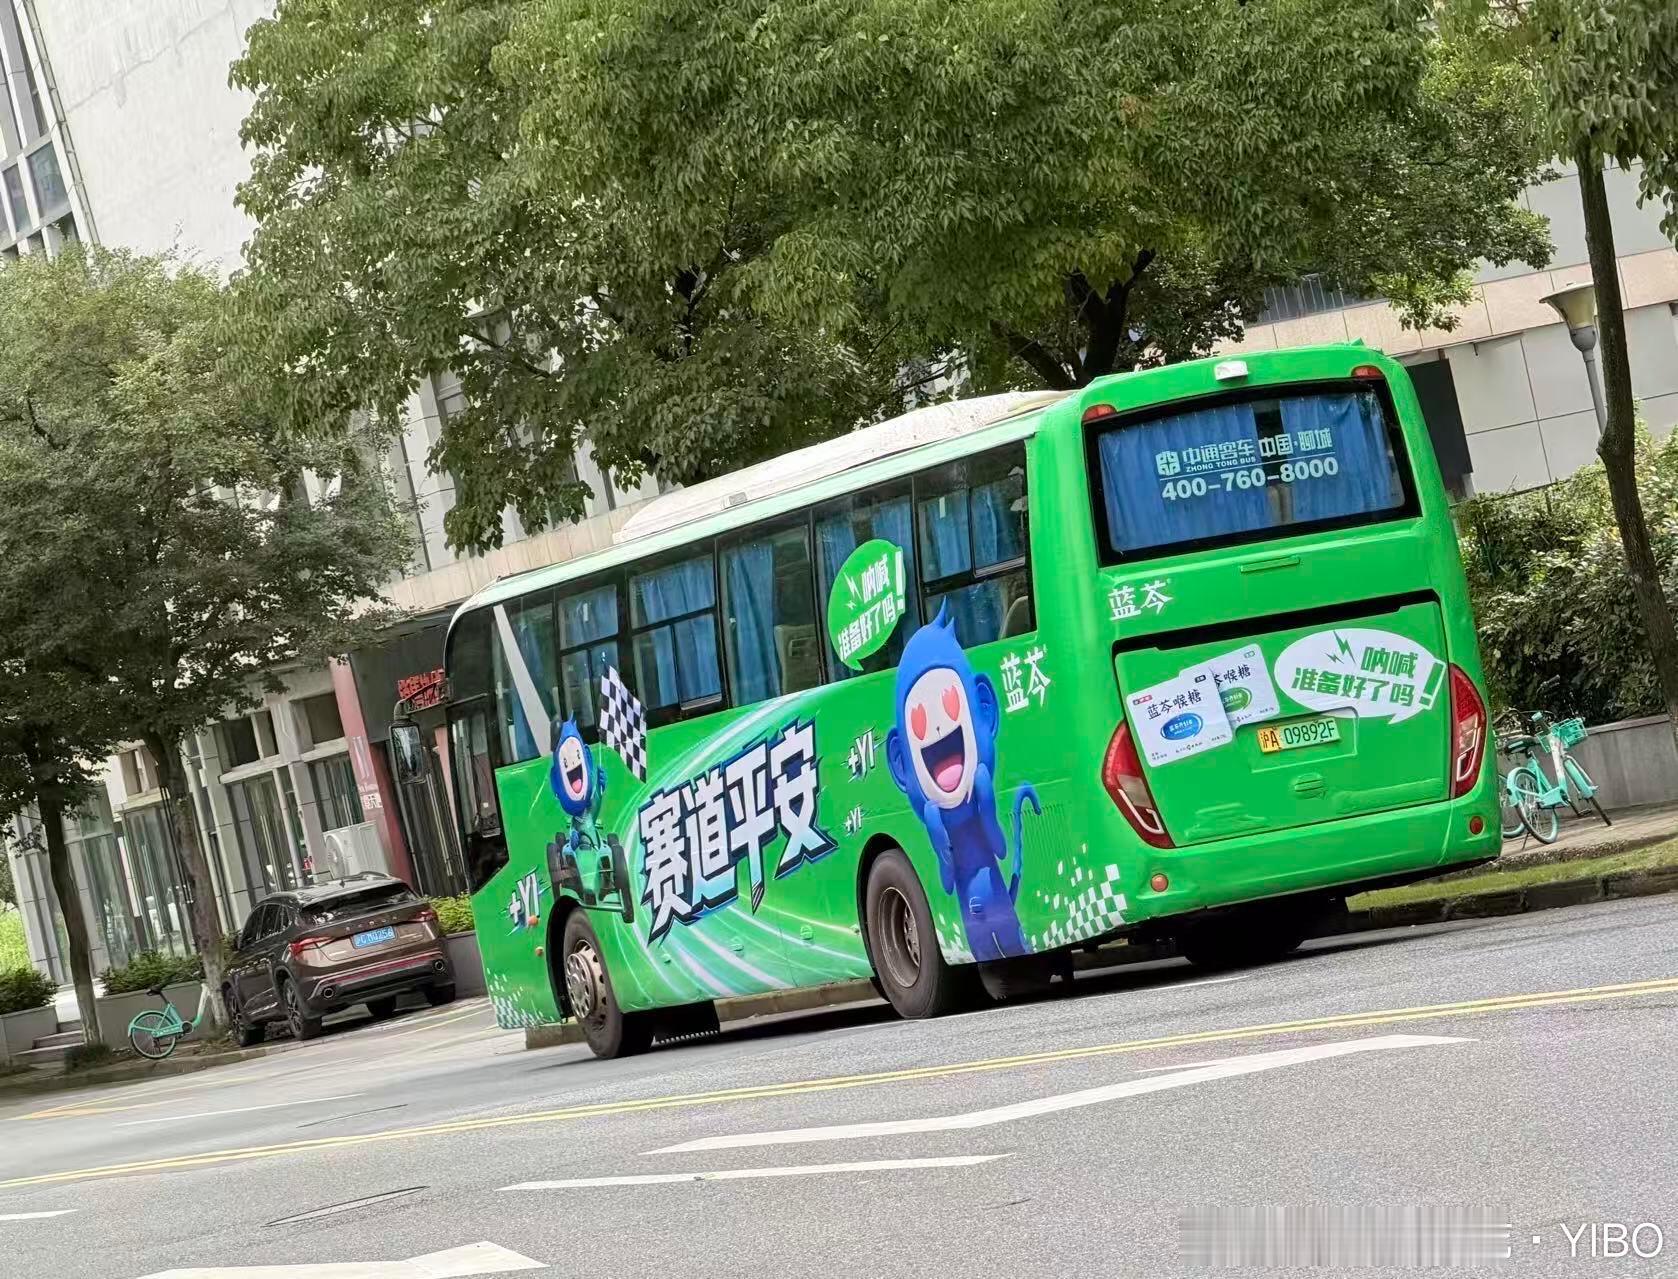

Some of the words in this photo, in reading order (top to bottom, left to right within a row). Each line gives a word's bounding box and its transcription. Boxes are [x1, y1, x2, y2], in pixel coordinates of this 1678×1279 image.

[1182, 439, 1255, 465] 中通客车
[1186, 463, 1214, 473] ZHONG
[1216, 458, 1238, 468] TONG
[1240, 456, 1256, 464] BUS
[1161, 456, 1339, 501] 400-760-8000
[862, 553, 890, 604] 呐喊
[1107, 579, 1173, 621] 蓝芩
[1000, 646, 1051, 712] 蓝芩
[1361, 646, 1418, 678] 呐喊
[1146, 689, 1202, 720] 蓝芩喉糖
[1261, 720, 1335, 749] 沪A09892F
[638, 719, 837, 943] 赛道平安
